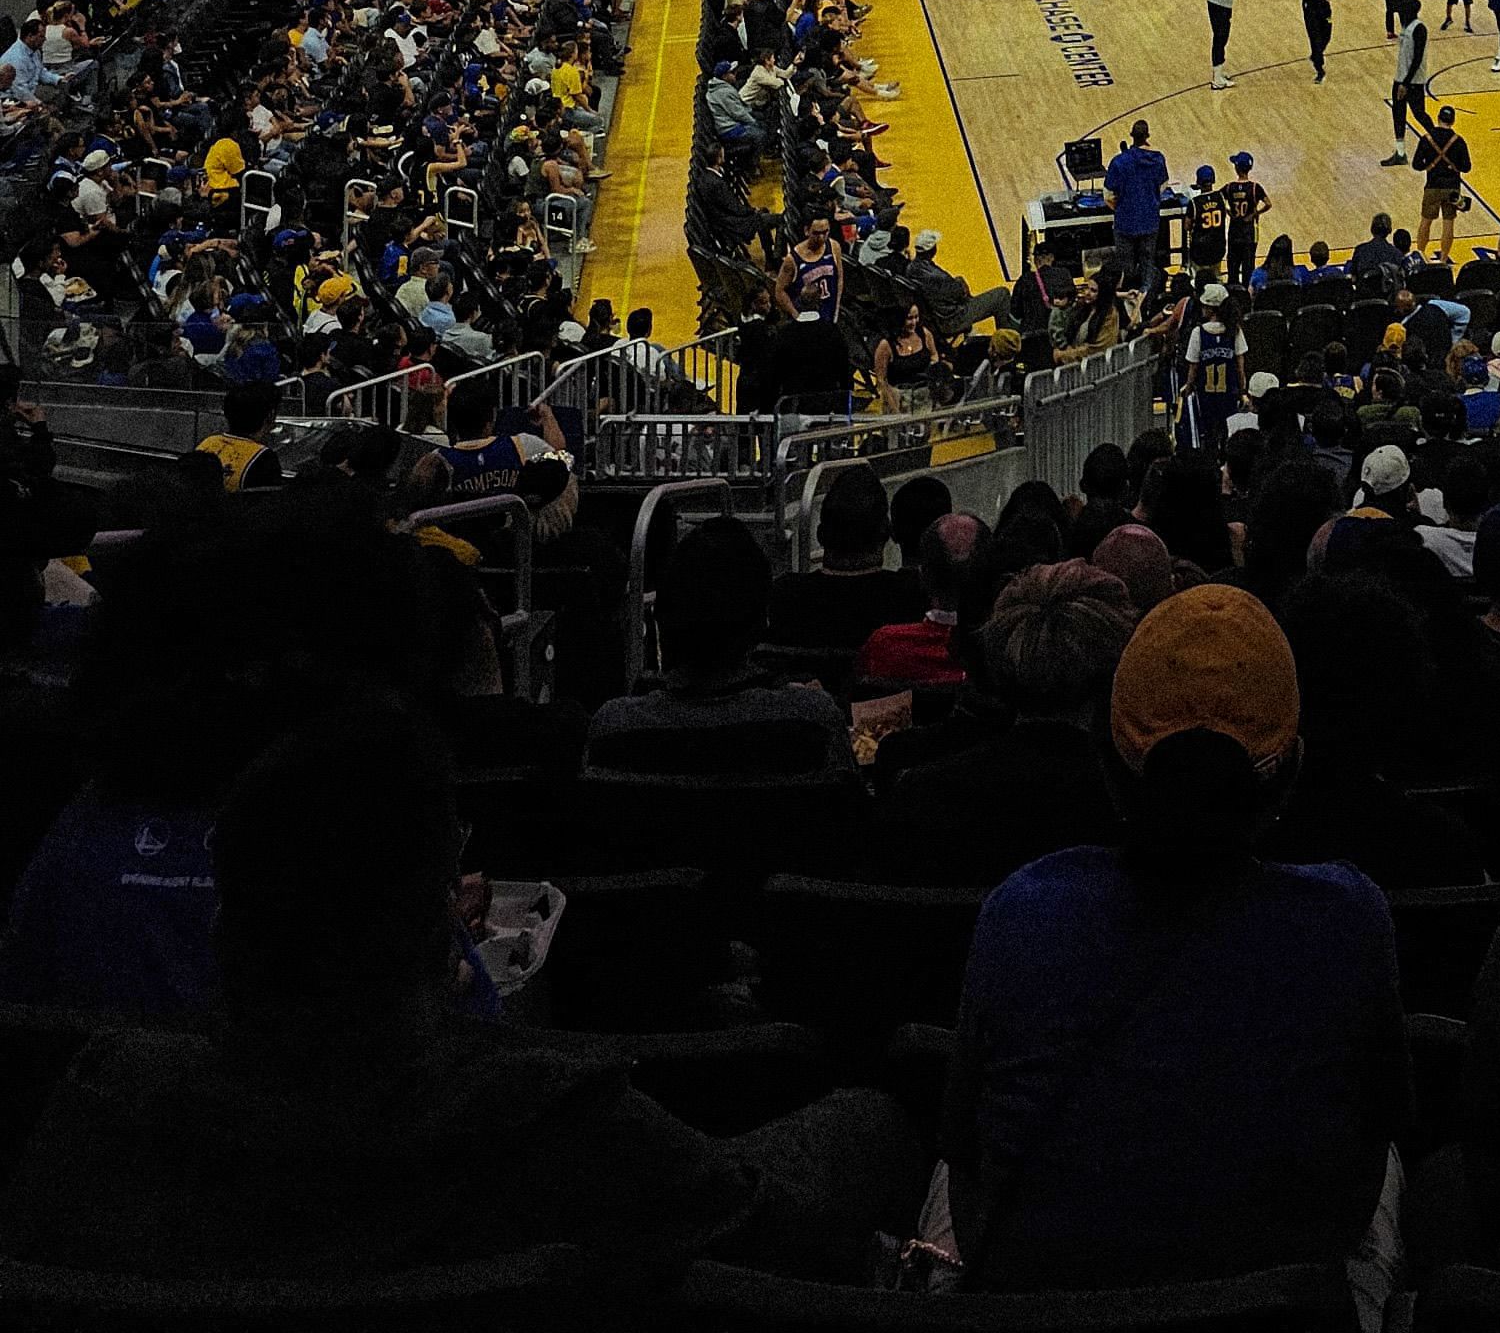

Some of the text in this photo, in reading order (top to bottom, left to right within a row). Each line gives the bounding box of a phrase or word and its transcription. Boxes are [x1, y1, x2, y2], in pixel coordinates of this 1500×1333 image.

[1061, 45, 1115, 89] CENTER
[551, 211, 564, 221] 14
[1201, 209, 1222, 229] 30
[1233, 200, 1249, 219] 30
[1204, 363, 1227, 393] 11
[454, 468, 521, 492] OMPSON
